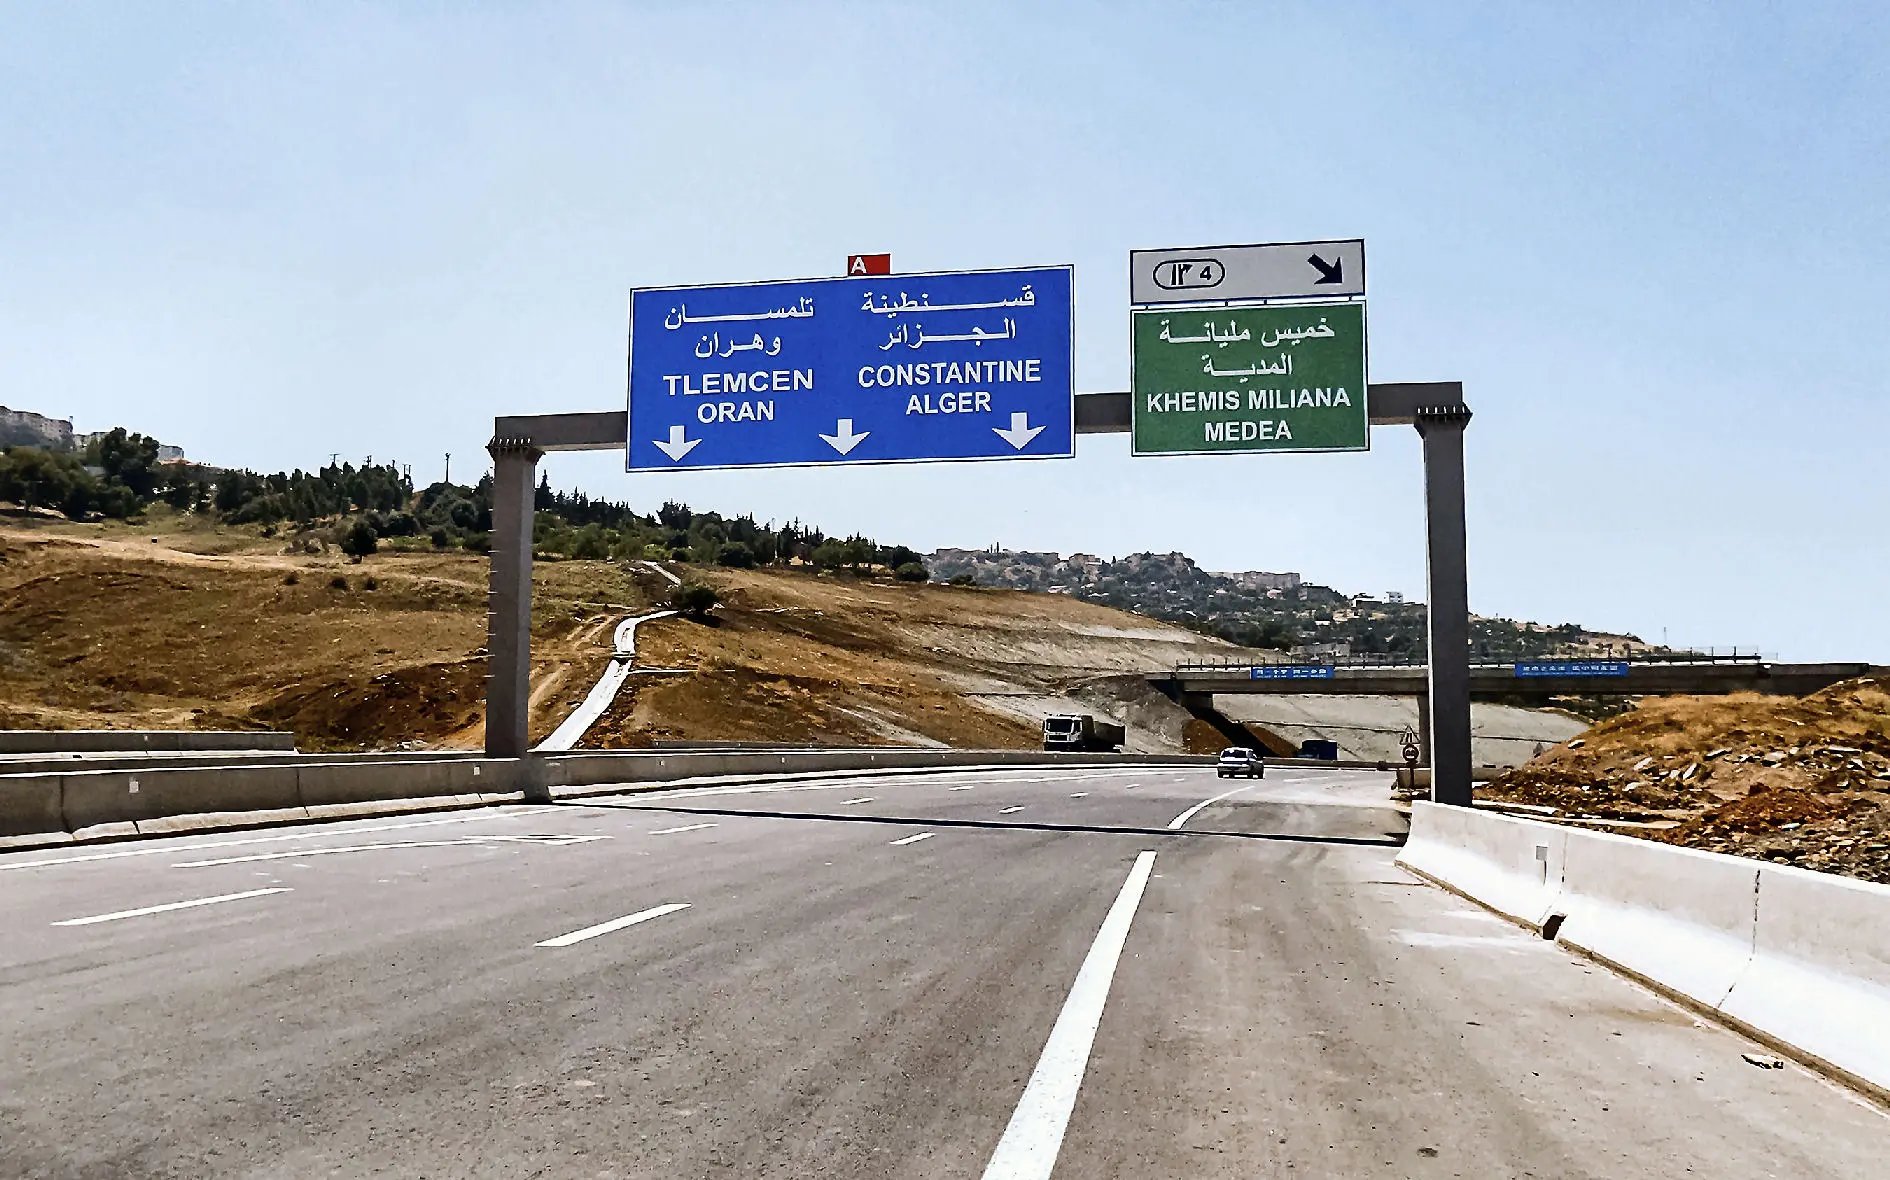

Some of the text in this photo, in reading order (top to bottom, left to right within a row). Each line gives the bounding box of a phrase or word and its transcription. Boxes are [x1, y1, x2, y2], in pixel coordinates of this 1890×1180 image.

[851, 257, 866, 274] A
[1199, 265, 1213, 281] 4
[664, 296, 814, 330] تلمسان
[695, 331, 781, 358] وهران
[1159, 317, 1335, 349] خميس مليانة
[858, 359, 1042, 388] CONSTANTINE
[1200, 352, 1293, 383] المدية
[662, 368, 813, 396] TLEMCEN
[697, 400, 774, 424] ORAN
[905, 391, 992, 415] ALGER
[1147, 387, 1352, 413] KHEMIS MILIANA
[1204, 419, 1293, 442] MEDEA
